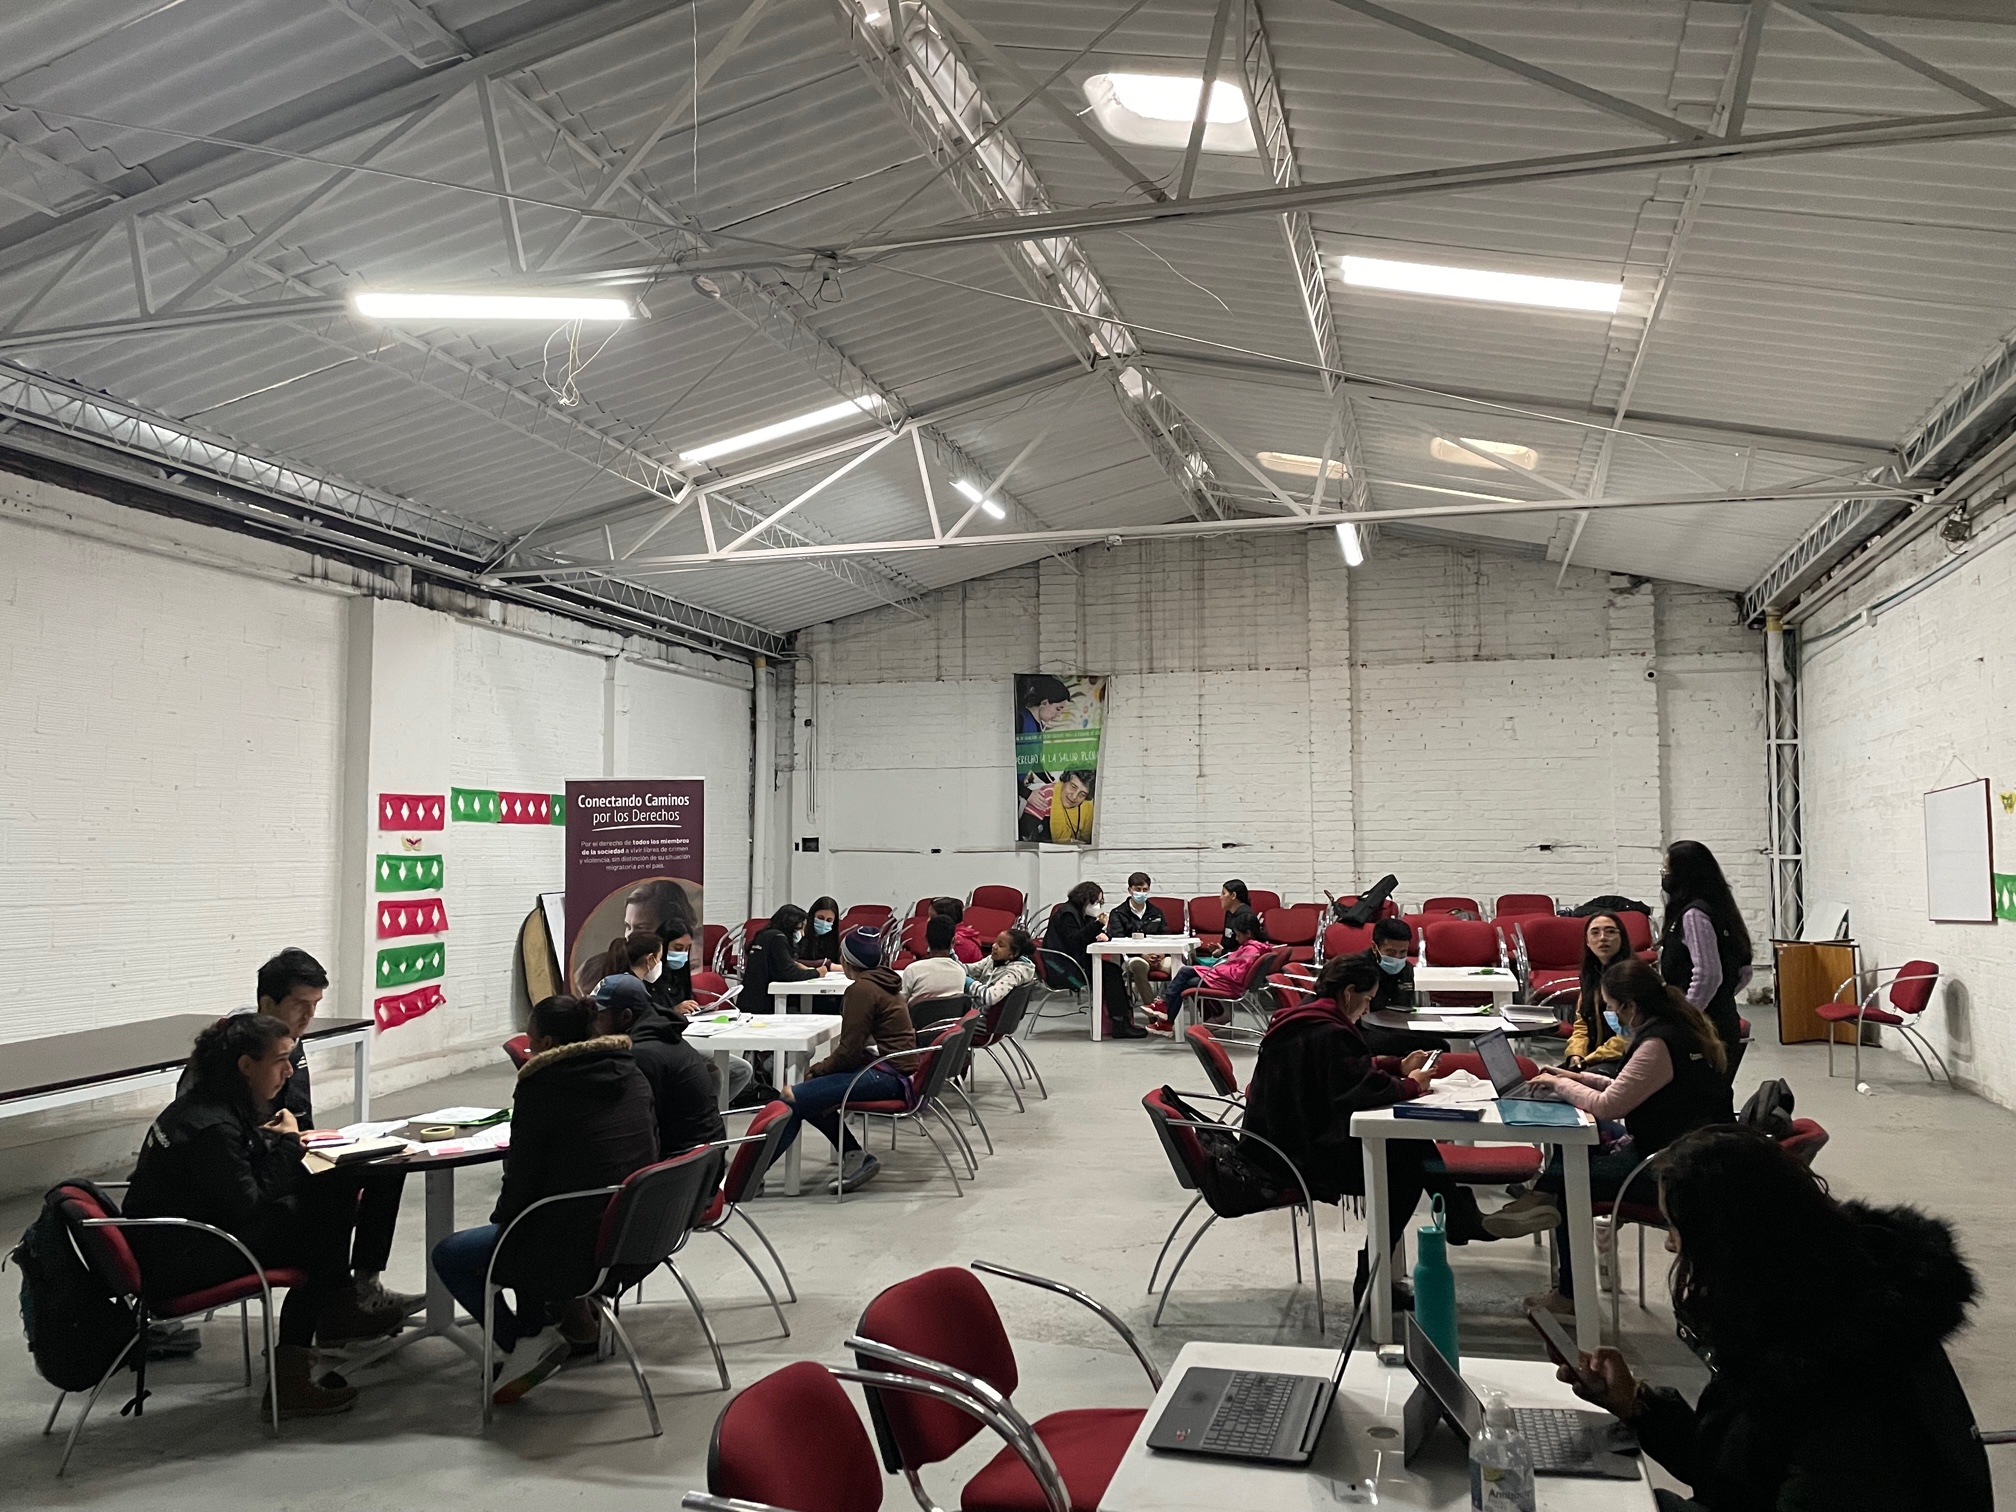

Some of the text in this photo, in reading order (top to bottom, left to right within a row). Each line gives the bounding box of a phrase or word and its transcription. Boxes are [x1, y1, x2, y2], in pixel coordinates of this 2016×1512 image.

[1016, 752, 1038, 765] ERECHO
[1039, 753, 1045, 764] A
[1048, 753, 1056, 763] LA
[1059, 751, 1078, 763] SALUD
[578, 793, 689, 808] Conectando Caminos
[593, 808, 680, 826] por los Derechos
